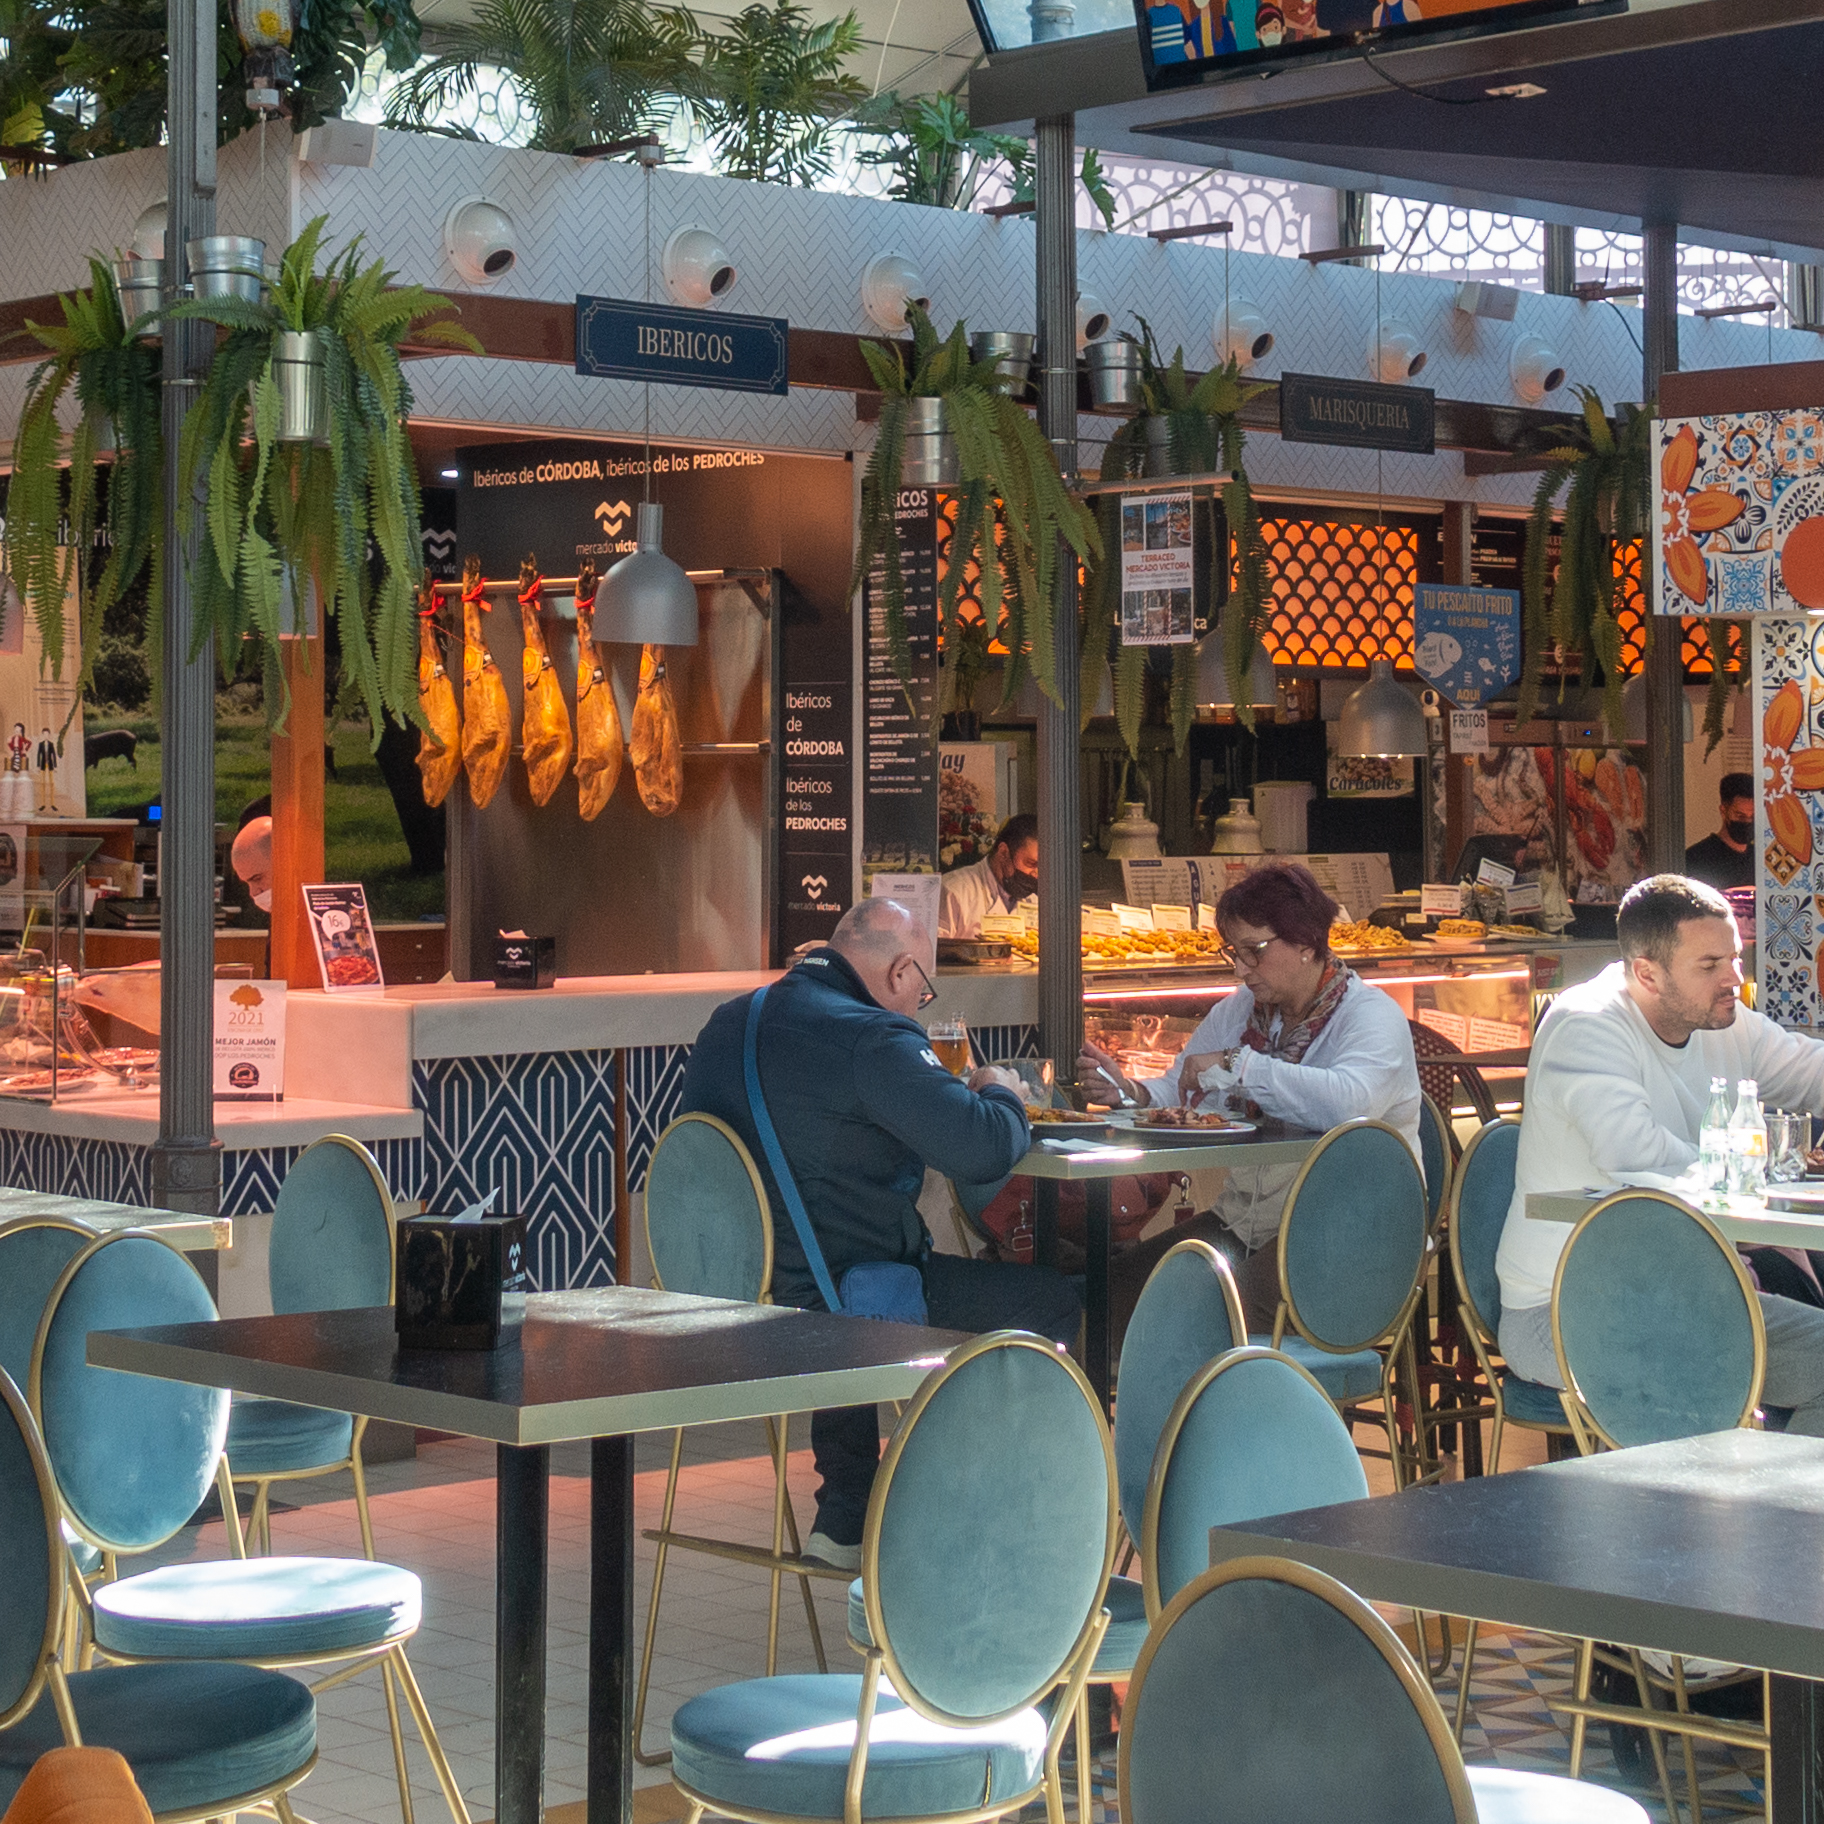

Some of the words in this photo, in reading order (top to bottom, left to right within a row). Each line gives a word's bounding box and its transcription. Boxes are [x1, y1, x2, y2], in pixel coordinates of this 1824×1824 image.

[638, 325, 733, 364] IBERICOS
[1309, 396, 1410, 430] MARISQUERIA
[474, 469, 517, 488] Ibéricos
[519, 468, 534, 484] de
[536, 459, 604, 483] CÓRDOBA,
[606, 459, 651, 477] ibéricos
[653, 455, 669, 473] de
[671, 453, 689, 472] los
[693, 452, 765, 470] PEDROCHES
[576, 541, 614, 556] mercado
[1125, 563, 1158, 574] MERCADO
[1159, 561, 1191, 573] VICTORIA
[1485, 595, 1513, 616] FRITO
[786, 693, 832, 709] Ibéricos
[786, 716, 802, 732] de
[1452, 714, 1486, 728] FRITOS
[786, 738, 844, 756] CÓRDOBA
[786, 777, 832, 794] Ibéricos
[1330, 777, 1402, 790] Caracoles
[786, 799, 798, 811] de
[799, 799, 812, 812] los
[786, 817, 847, 831] PEDROCHES
[787, 901, 815, 911] mercado
[816, 901, 841, 912] victoria
[228, 1011, 264, 1025] 2021
[215, 1038, 244, 1046] MEJOR
[246, 1036, 276, 1046] JAMÓN
